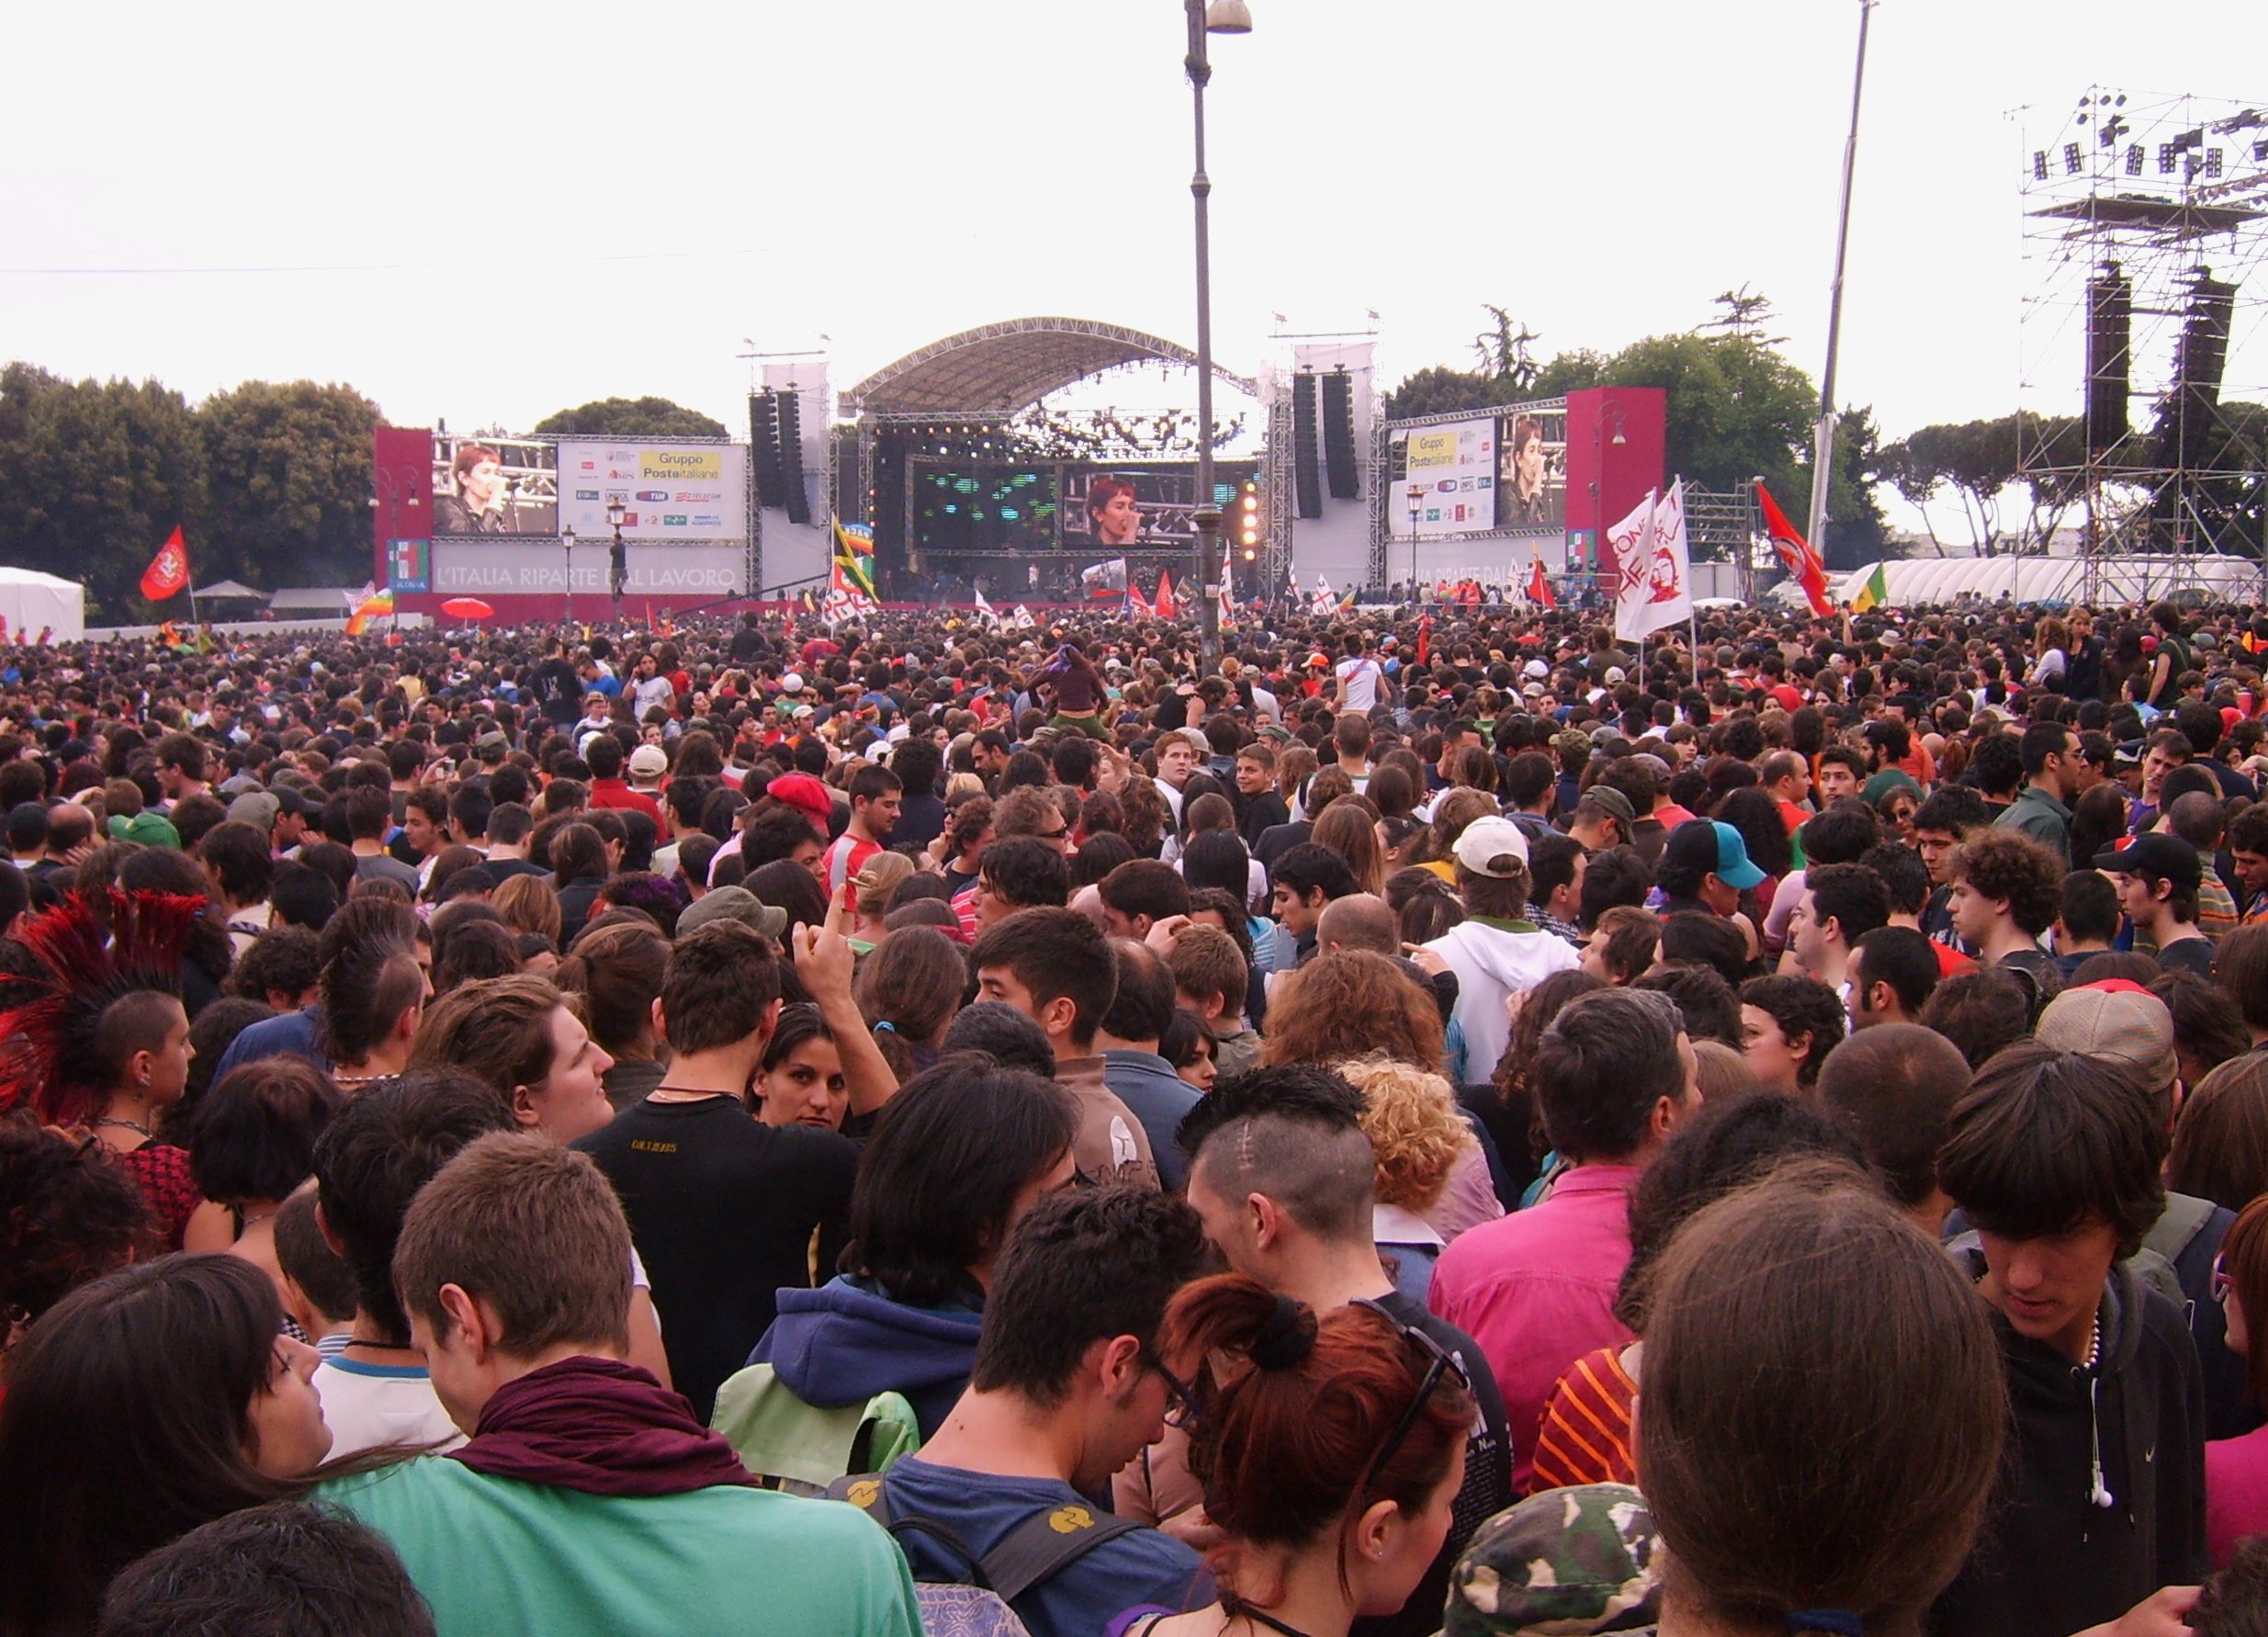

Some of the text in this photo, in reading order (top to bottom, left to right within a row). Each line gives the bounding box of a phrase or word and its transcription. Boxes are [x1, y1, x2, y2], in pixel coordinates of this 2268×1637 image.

[1420, 437, 1445, 451] Gruppo
[660, 453, 704, 466] Gruppo
[437, 567, 513, 585] L'ITALIA
[520, 568, 597, 586] RIPARTE
[649, 569, 736, 586] LAVORO
